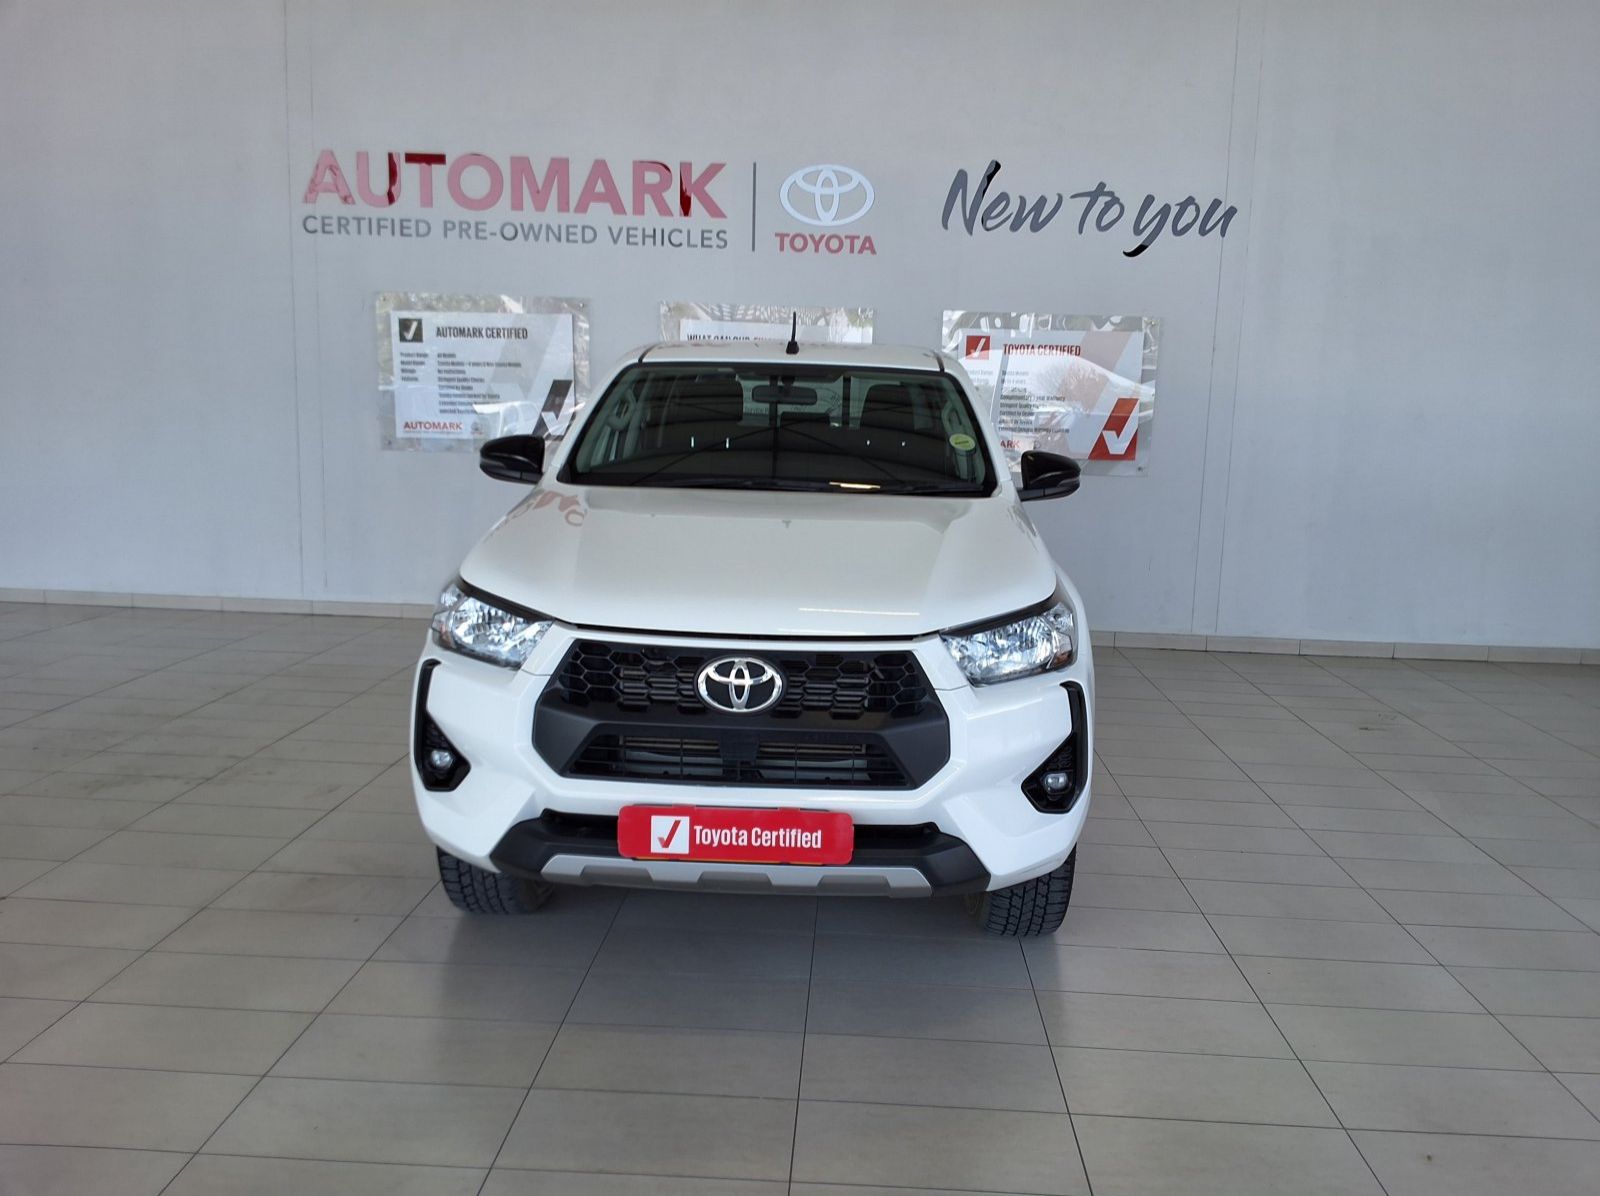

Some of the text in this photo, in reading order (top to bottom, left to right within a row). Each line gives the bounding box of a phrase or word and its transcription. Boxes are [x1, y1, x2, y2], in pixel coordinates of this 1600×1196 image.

[302, 149, 728, 219] AUTOMARK
[942, 159, 1238, 258] New to you
[302, 214, 728, 249] CERTIFIED PRE-OWNED VEHICLES
[774, 232, 877, 255] TOYOTA
[436, 326, 528, 340] AUTOMARK CERTIFIED
[1003, 343, 1081, 357] TOYOTA CERTIFIED
[403, 420, 463, 431] AUTOMARK
[693, 825, 822, 849] Toyota Certified
